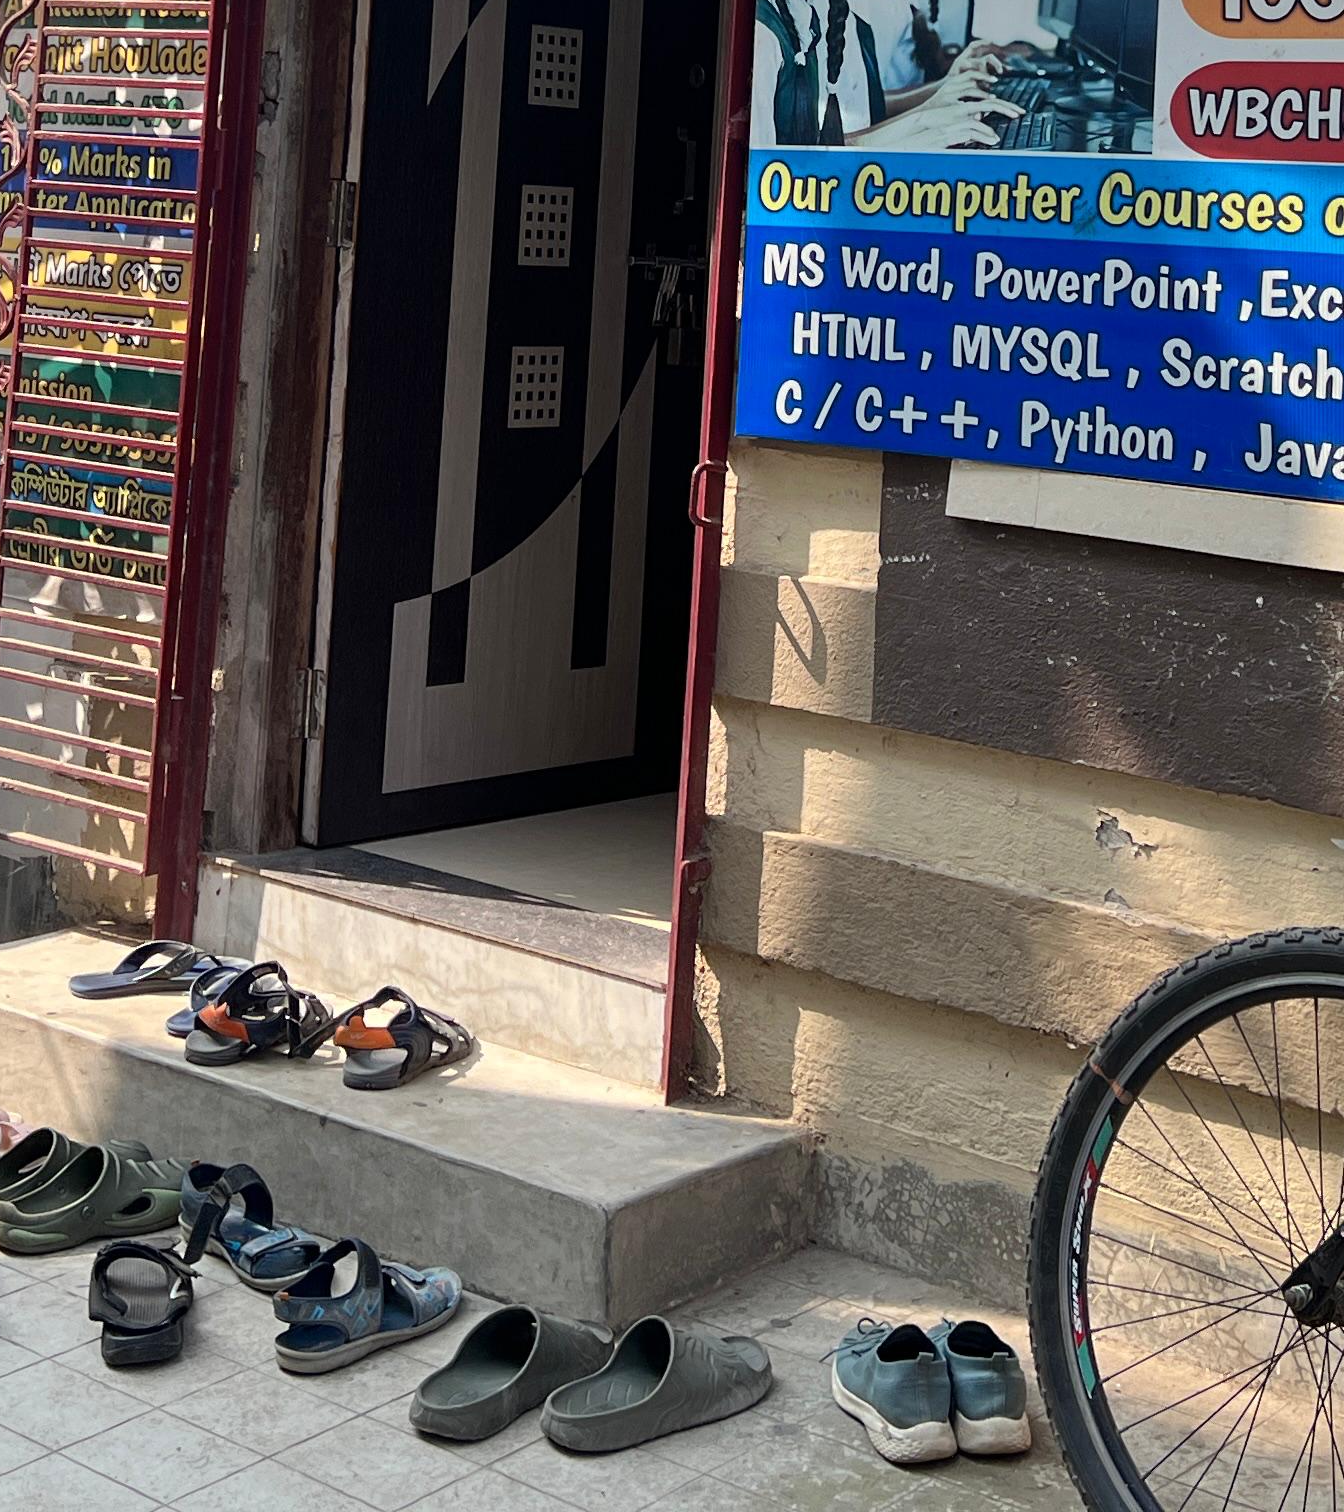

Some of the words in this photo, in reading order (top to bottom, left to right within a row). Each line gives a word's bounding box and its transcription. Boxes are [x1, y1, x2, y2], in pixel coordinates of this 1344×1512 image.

[89, 36, 208, 75] Howlade
[1, 144, 63, 176] 1%
[68, 144, 142, 180] Marks
[147, 146, 172, 180] in
[74, 191, 197, 230] Applicatio
[759, 161, 834, 214] Our
[853, 164, 1081, 233] Computer
[1098, 172, 1304, 233] Courses
[45, 254, 114, 290] Marks
[763, 243, 826, 288] MS
[841, 246, 955, 301] Word,
[975, 255, 1224, 315] PowerPoint
[792, 313, 906, 364] HTML
[952, 324, 1109, 384] MYSQL
[1159, 341, 1344, 401] Scratch
[775, 379, 803, 426] C
[1019, 400, 1173, 464] Python
